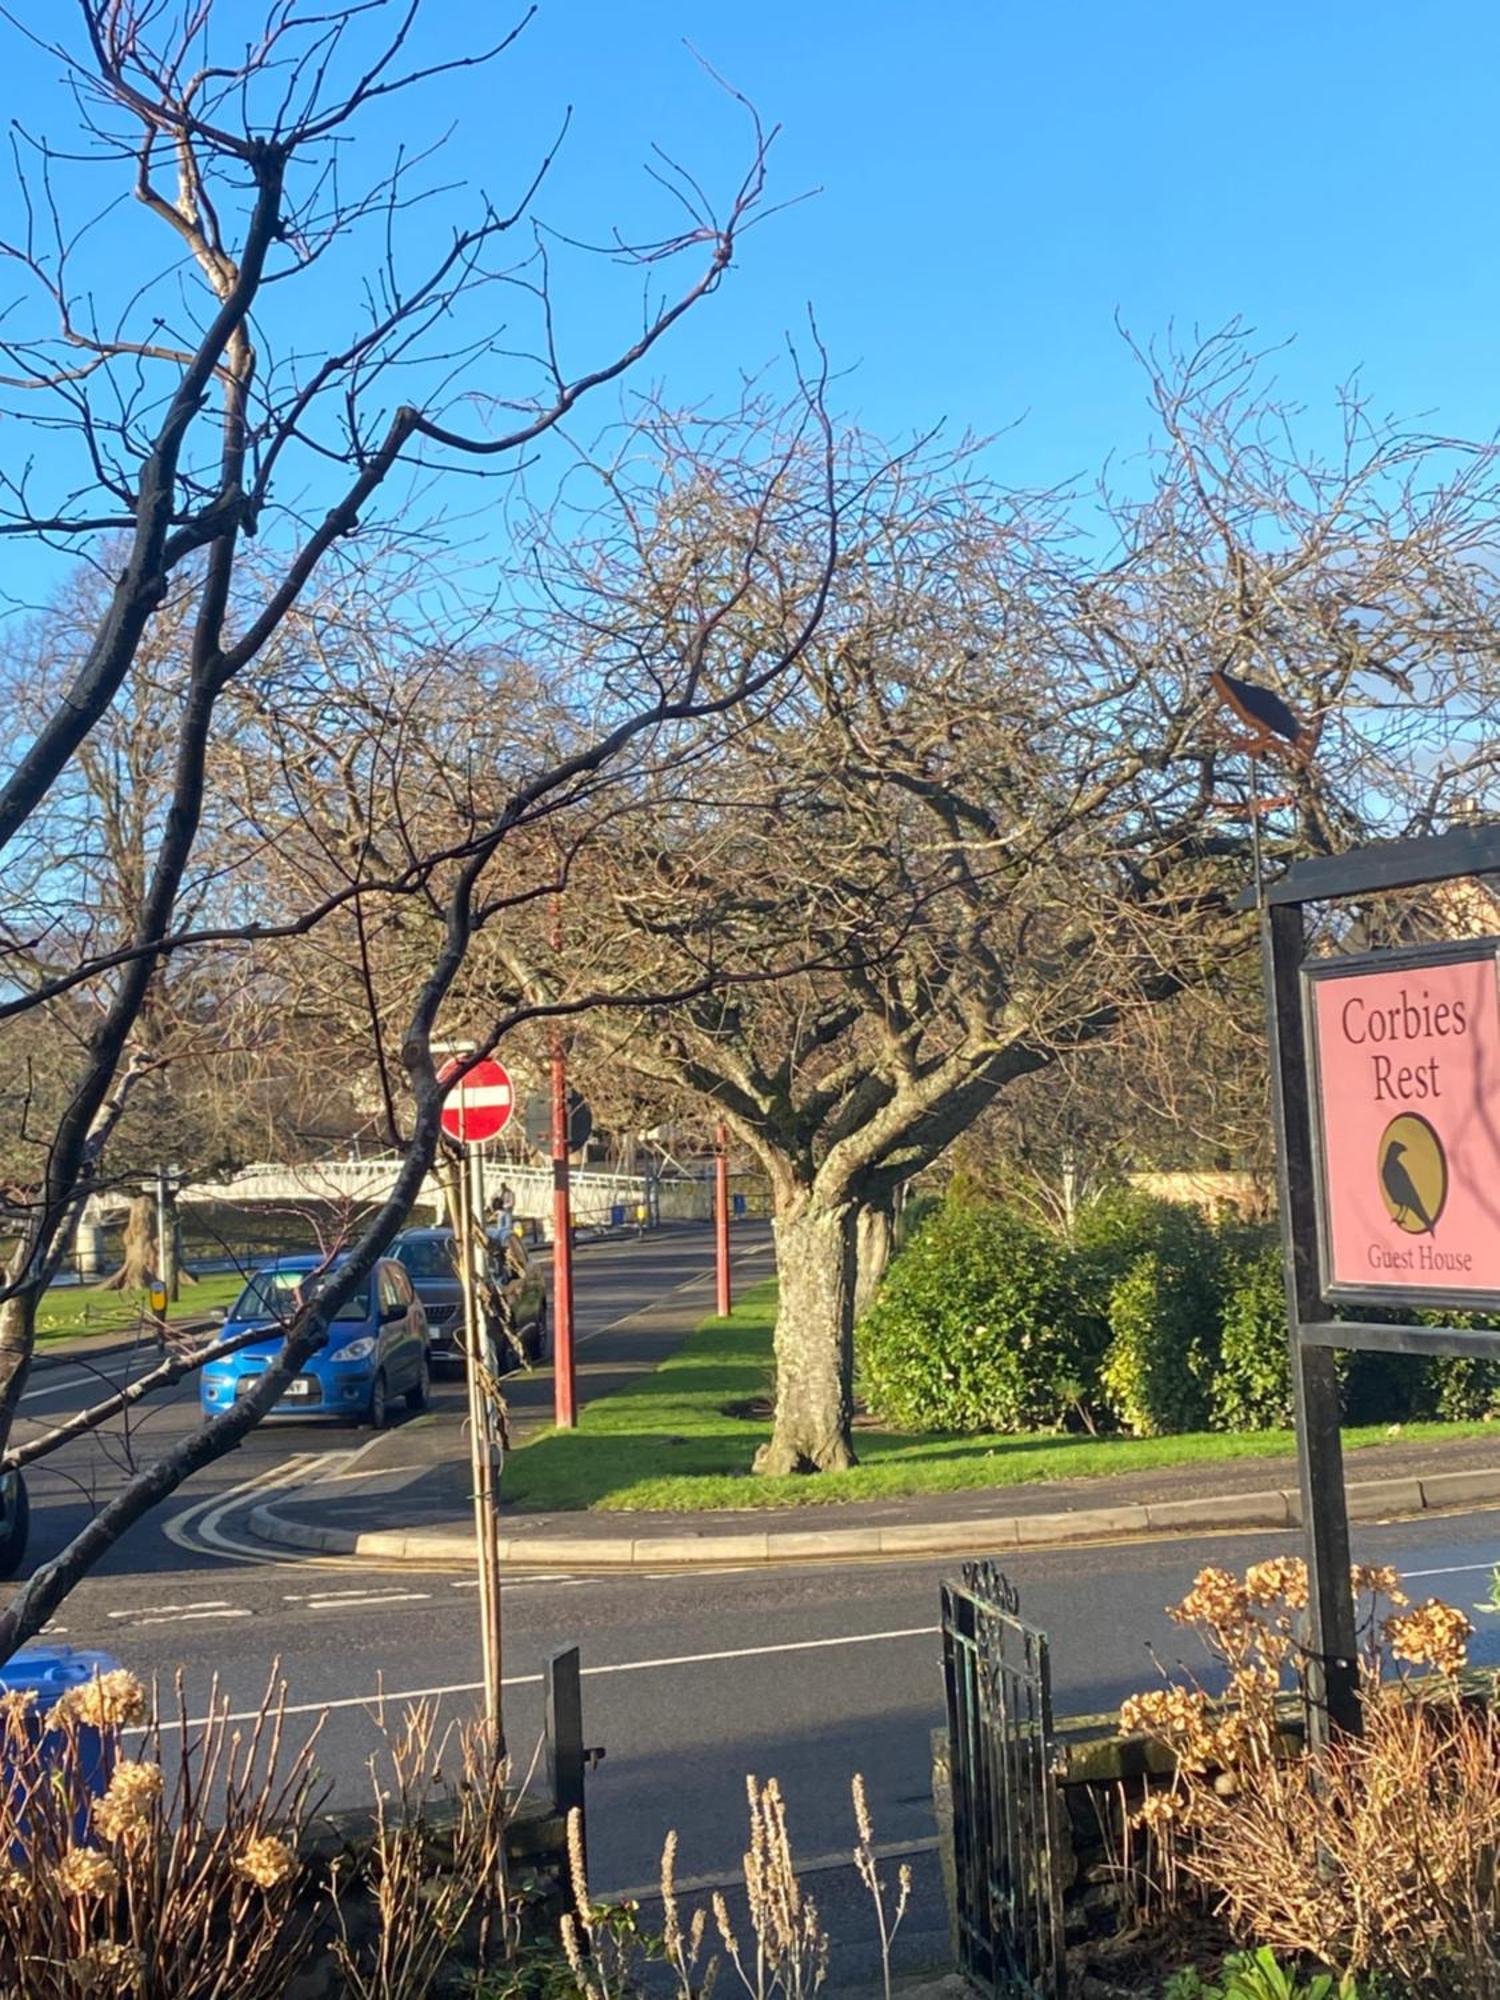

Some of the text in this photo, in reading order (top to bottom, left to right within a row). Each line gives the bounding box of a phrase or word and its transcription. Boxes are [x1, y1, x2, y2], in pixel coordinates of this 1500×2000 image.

[1342, 990, 1466, 1044] Corbies
[1372, 1054, 1441, 1100] Rest
[1368, 1244, 1472, 1272] Guest House
